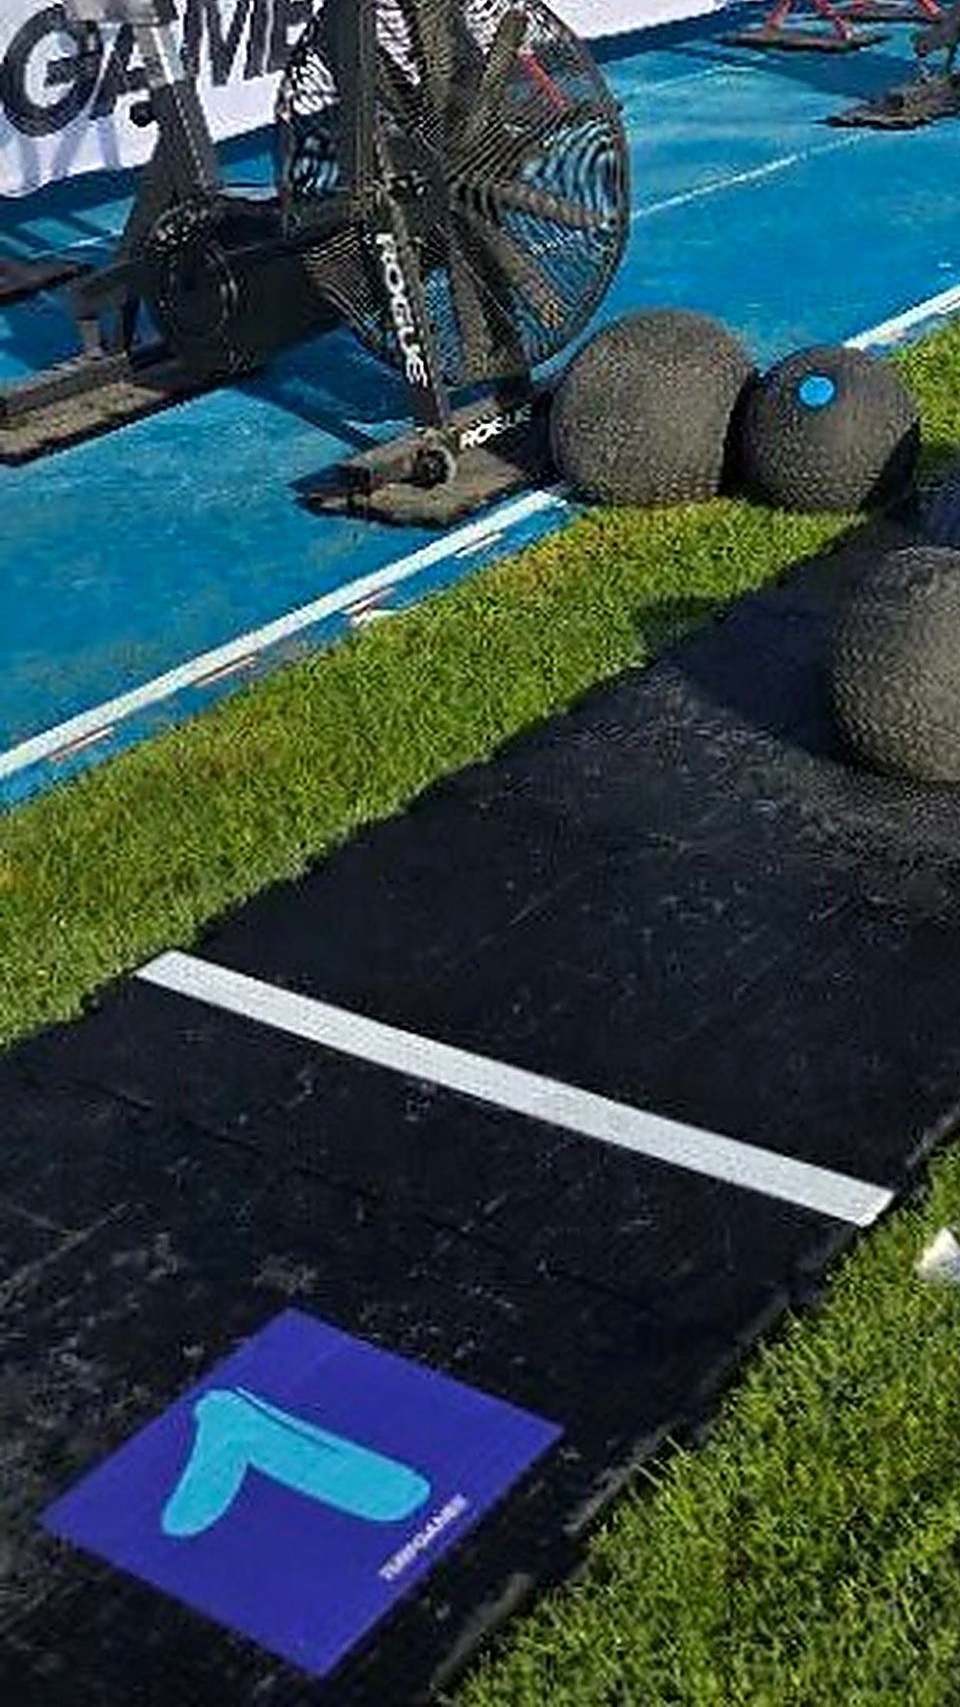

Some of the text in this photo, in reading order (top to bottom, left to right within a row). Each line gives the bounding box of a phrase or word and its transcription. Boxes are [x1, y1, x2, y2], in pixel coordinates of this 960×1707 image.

[375, 231, 430, 389] ROGUE
[459, 399, 534, 451] ROGUE
[161, 1386, 432, 1538] 1
